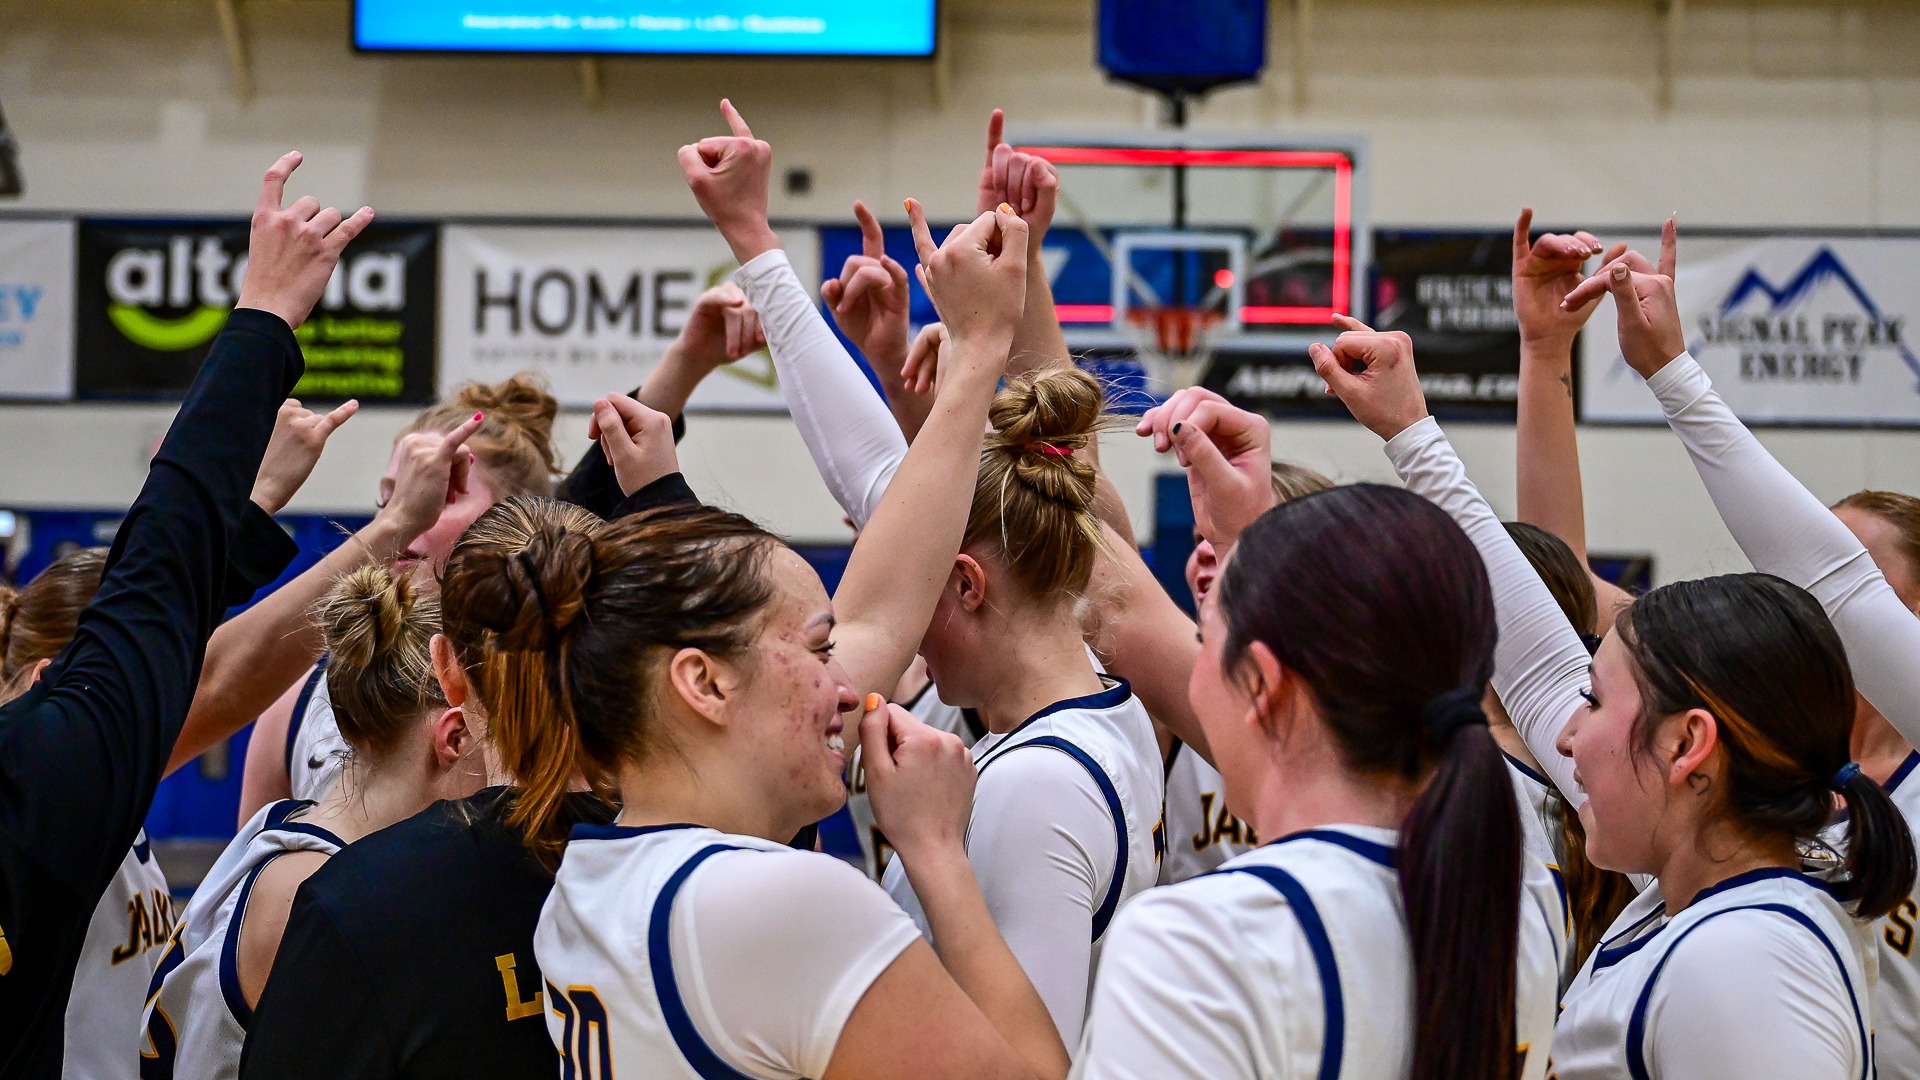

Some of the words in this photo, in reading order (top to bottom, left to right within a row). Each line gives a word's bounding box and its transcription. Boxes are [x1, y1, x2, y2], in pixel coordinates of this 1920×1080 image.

[1699, 313, 1808, 344] SIGNAL
[1823, 313, 1904, 345] PEAK
[1739, 352, 1864, 384] ENERGY
